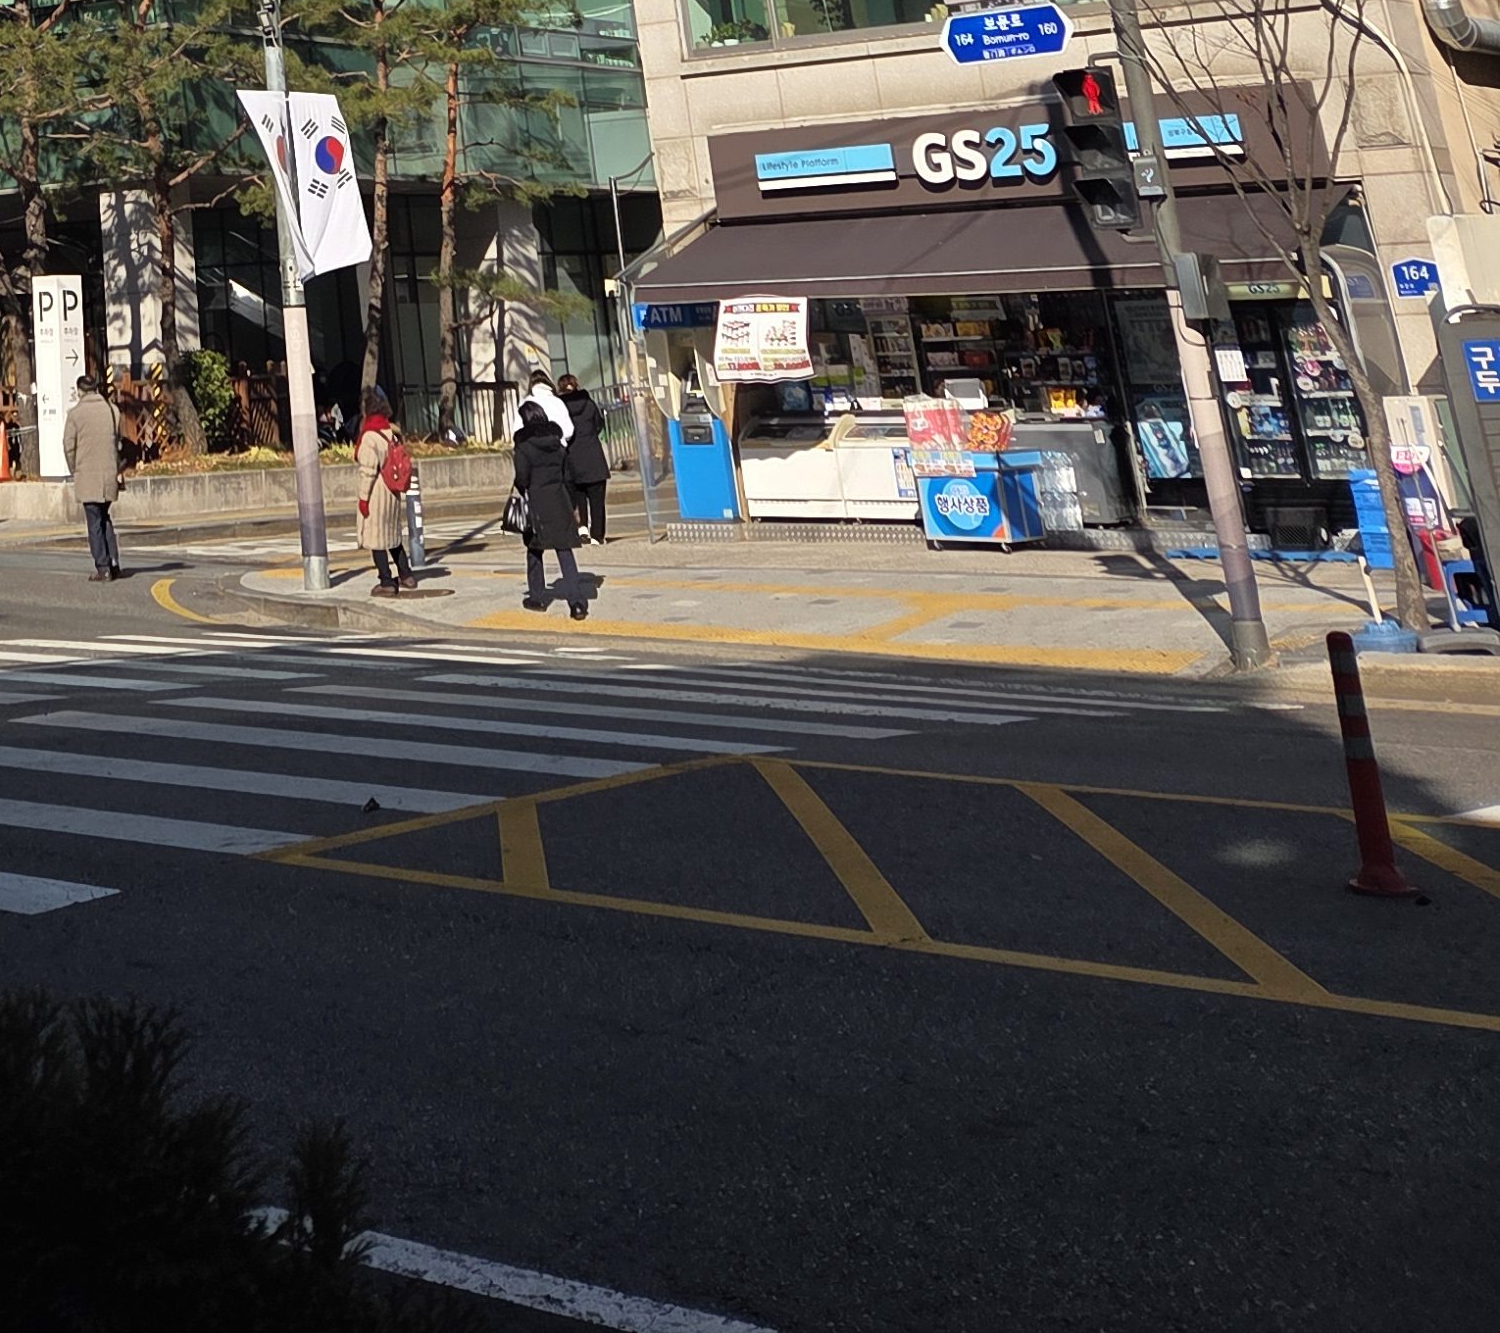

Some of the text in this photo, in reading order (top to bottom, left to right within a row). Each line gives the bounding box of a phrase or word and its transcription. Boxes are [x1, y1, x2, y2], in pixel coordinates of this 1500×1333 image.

[983, 14, 1025, 31] 보문로
[954, 33, 975, 47] 164
[1037, 23, 1059, 36] 160
[912, 123, 1058, 184] GS25
[1401, 265, 1430, 281] 164
[39, 291, 54, 322] P
[63, 289, 78, 322] P
[650, 306, 683, 324] ATM
[1469, 346, 1500, 394] 구두
[936, 495, 988, 514] 행사상품
